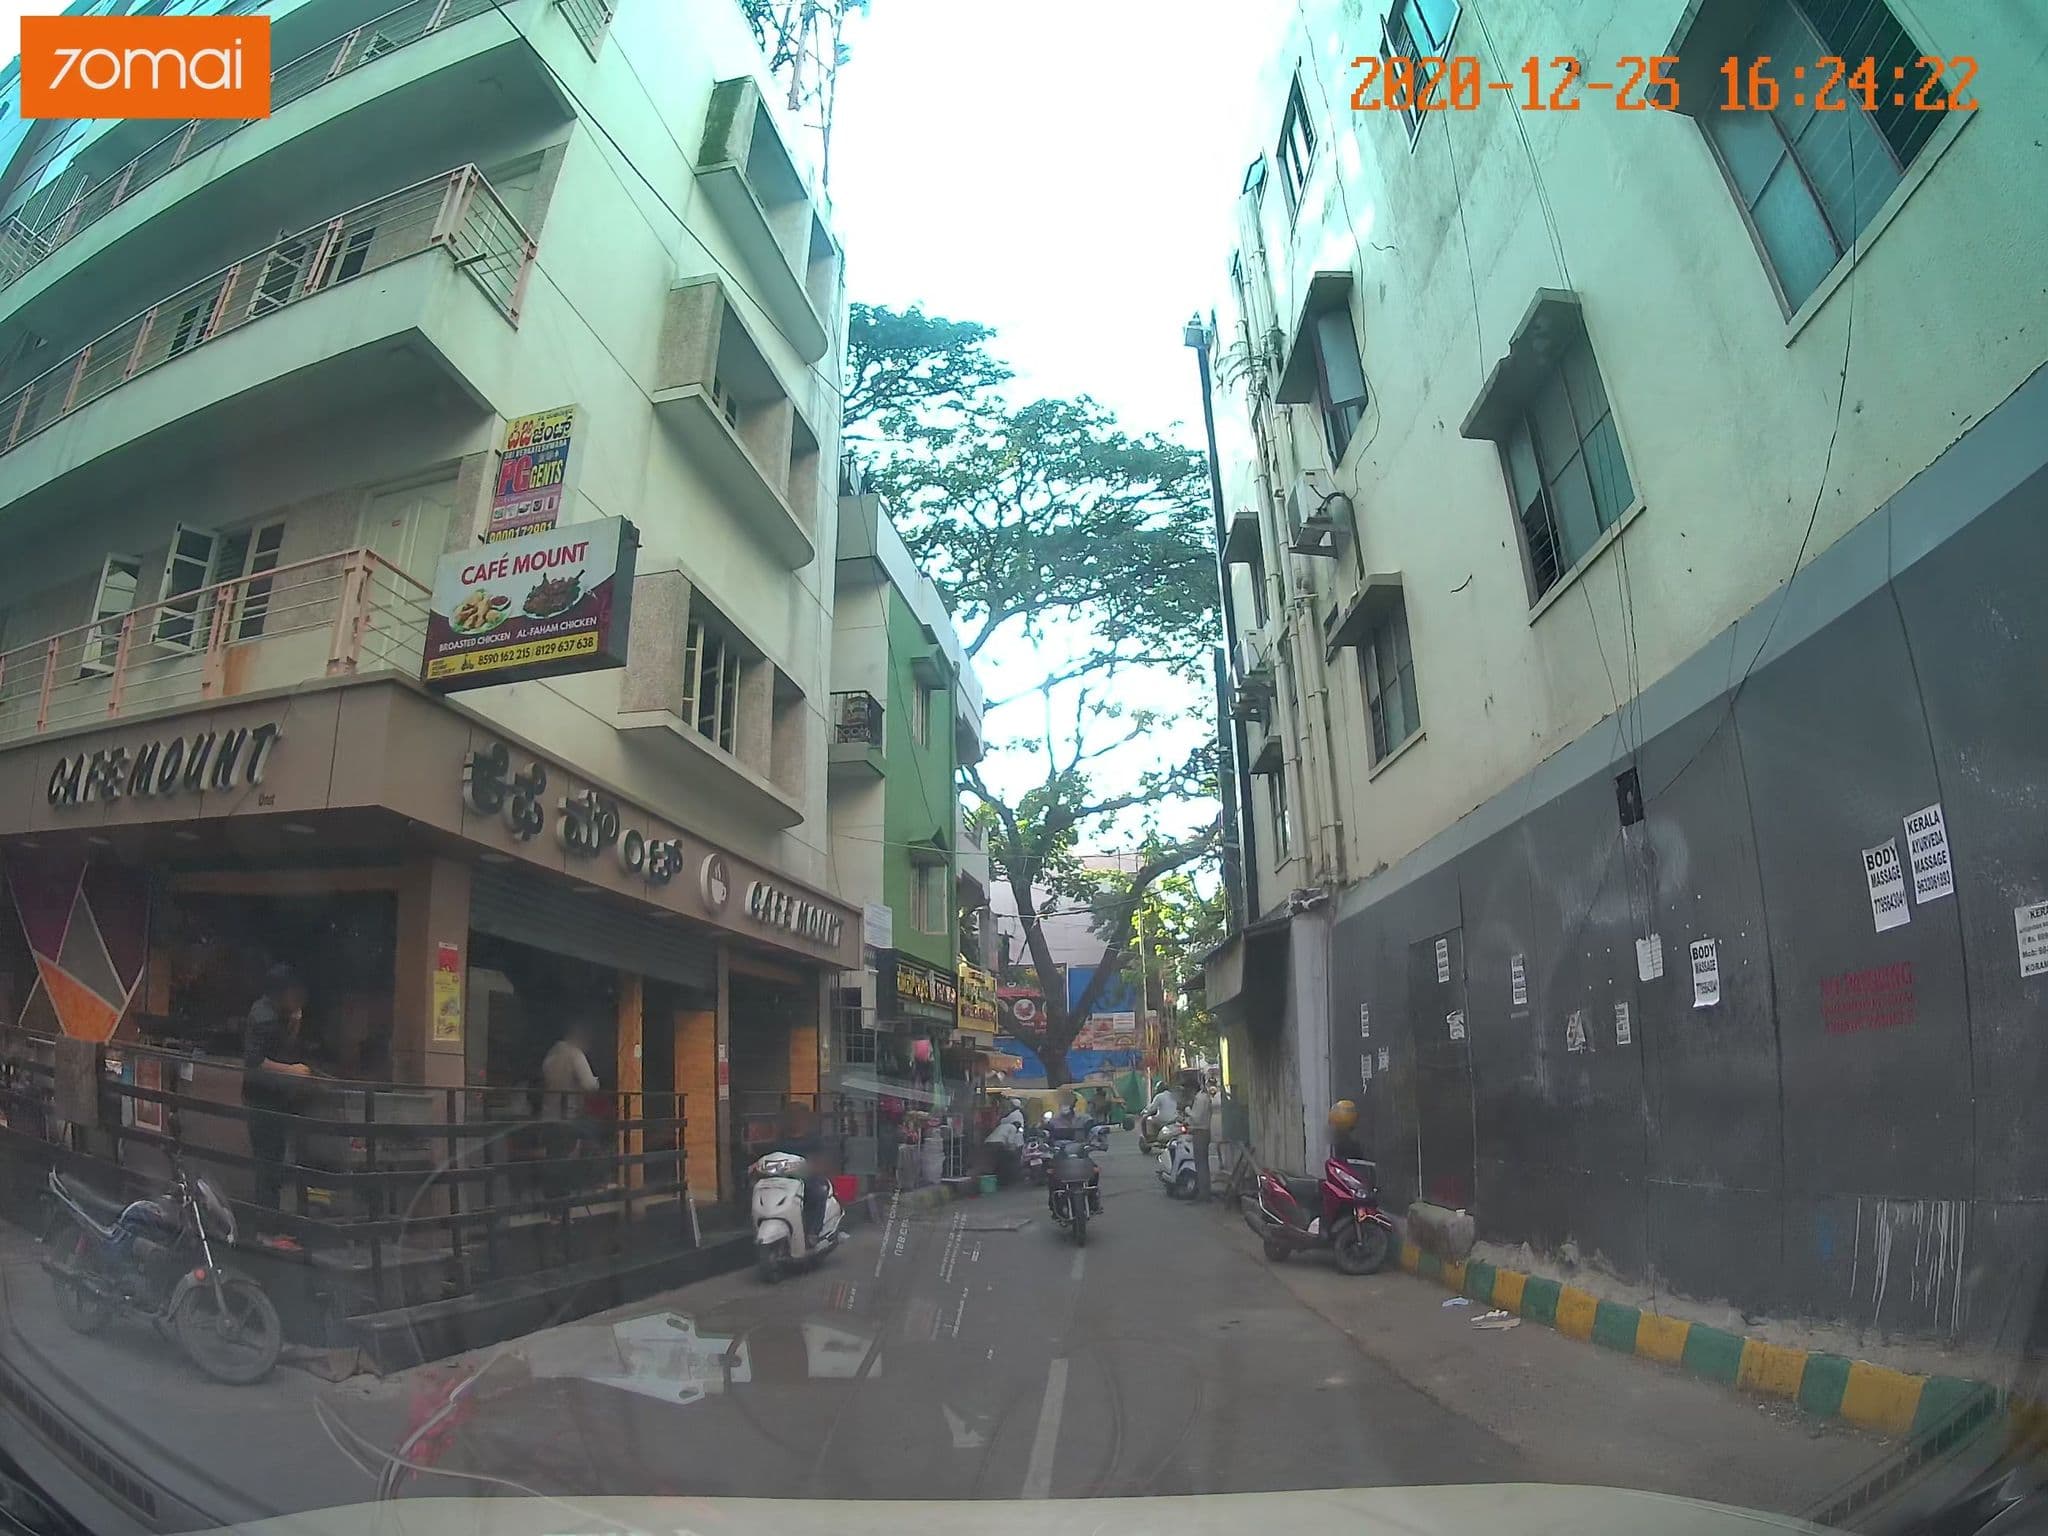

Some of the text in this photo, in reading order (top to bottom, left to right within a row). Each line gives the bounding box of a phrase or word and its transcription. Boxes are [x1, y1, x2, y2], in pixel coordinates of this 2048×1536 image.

[497, 454, 565, 495] PG GENTS
[461, 541, 589, 585] CAFÉ MOUNT
[439, 616, 597, 653] BROASTED CHICKEN AL-FAHAM CHICKEN
[477, 636, 594, 666] 8590 162 215 8129 637 638
[127, 722, 281, 796] MOUNT
[1907, 810, 1941, 835] KERALA
[1911, 830, 1944, 854] AYURVEDA
[1865, 845, 1898, 871] BODY
[1914, 850, 1947, 874] MASSAGE
[1870, 864, 1901, 888] MASSAGE
[790, 900, 840, 947] MOUNT
[1691, 943, 1715, 960] BODY
